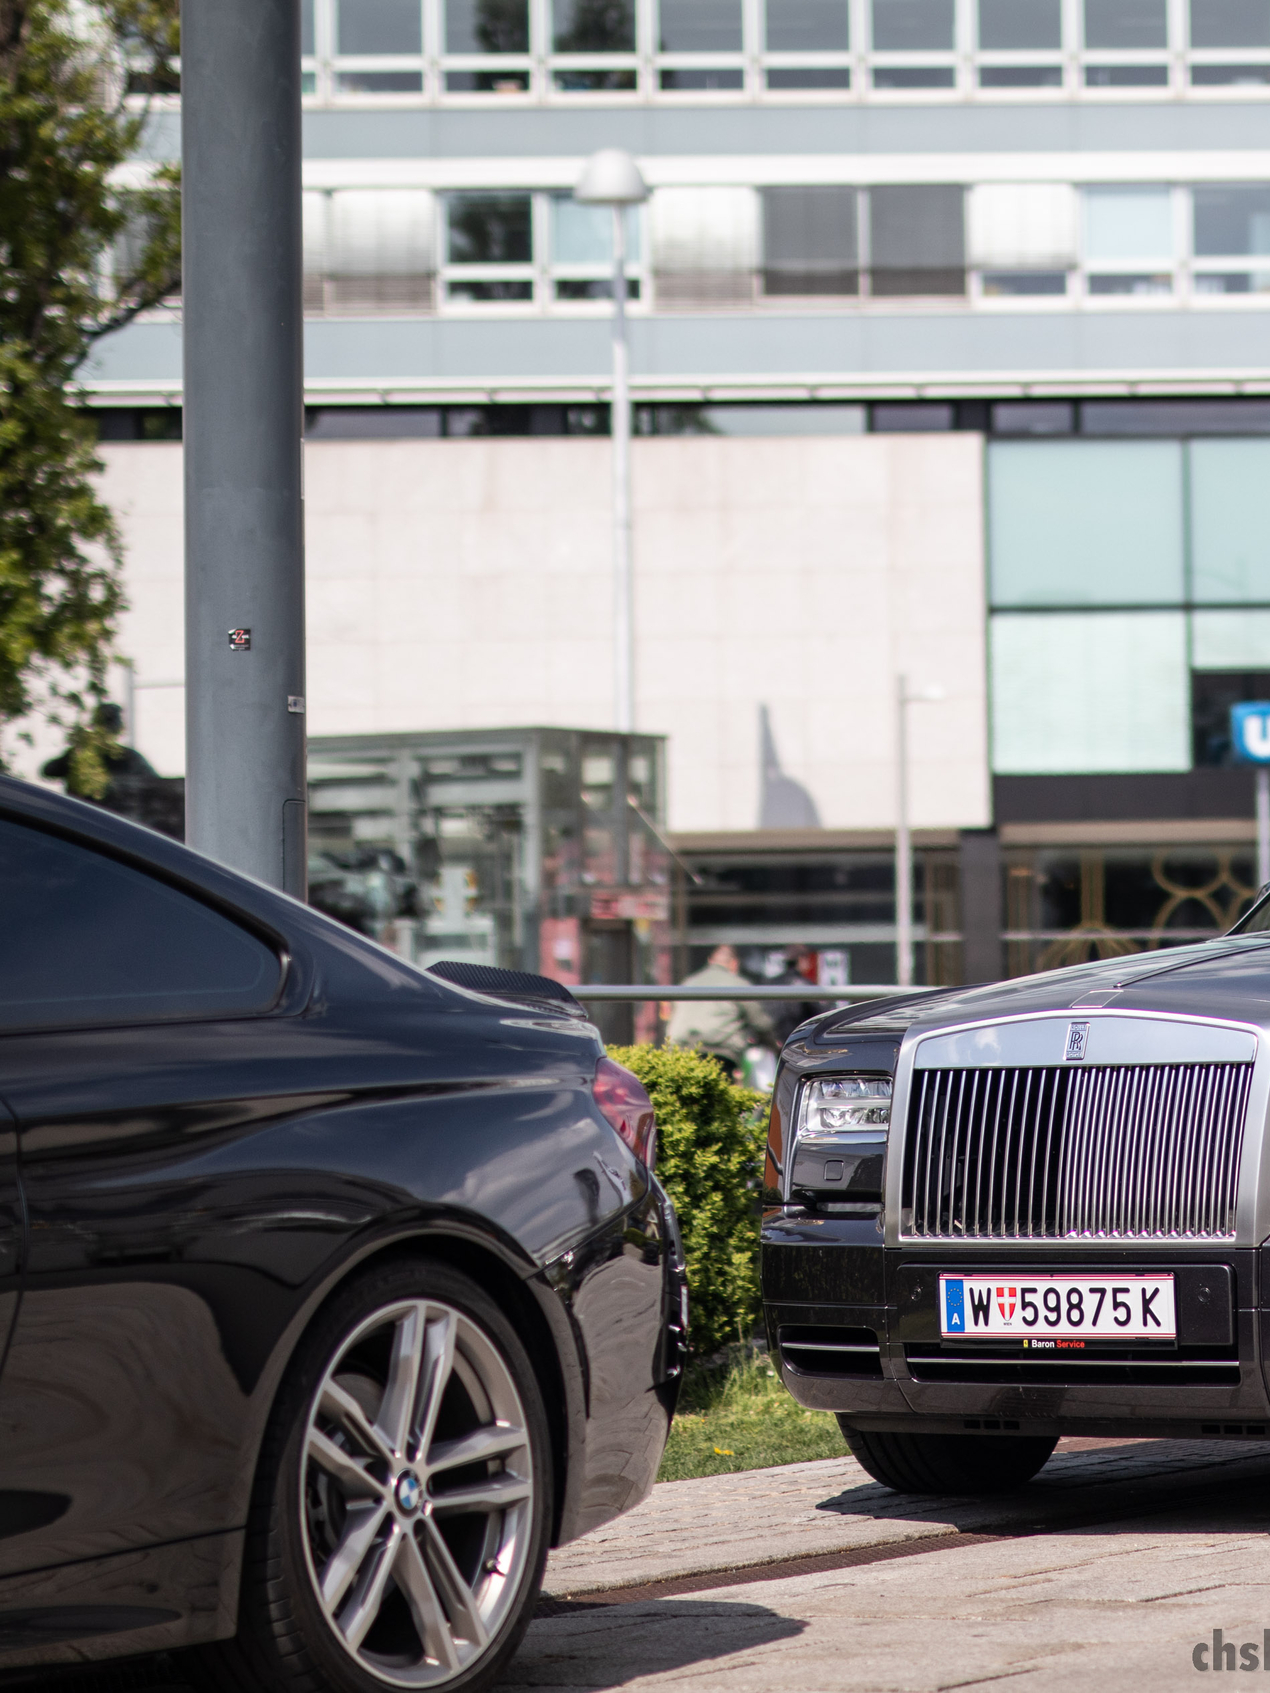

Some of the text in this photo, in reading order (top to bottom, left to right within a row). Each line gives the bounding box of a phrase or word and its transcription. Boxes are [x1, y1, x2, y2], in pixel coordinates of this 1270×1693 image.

[951, 1312, 961, 1325] A
[969, 1287, 992, 1327] W
[1031, 1339, 1085, 1348] Baron Service
